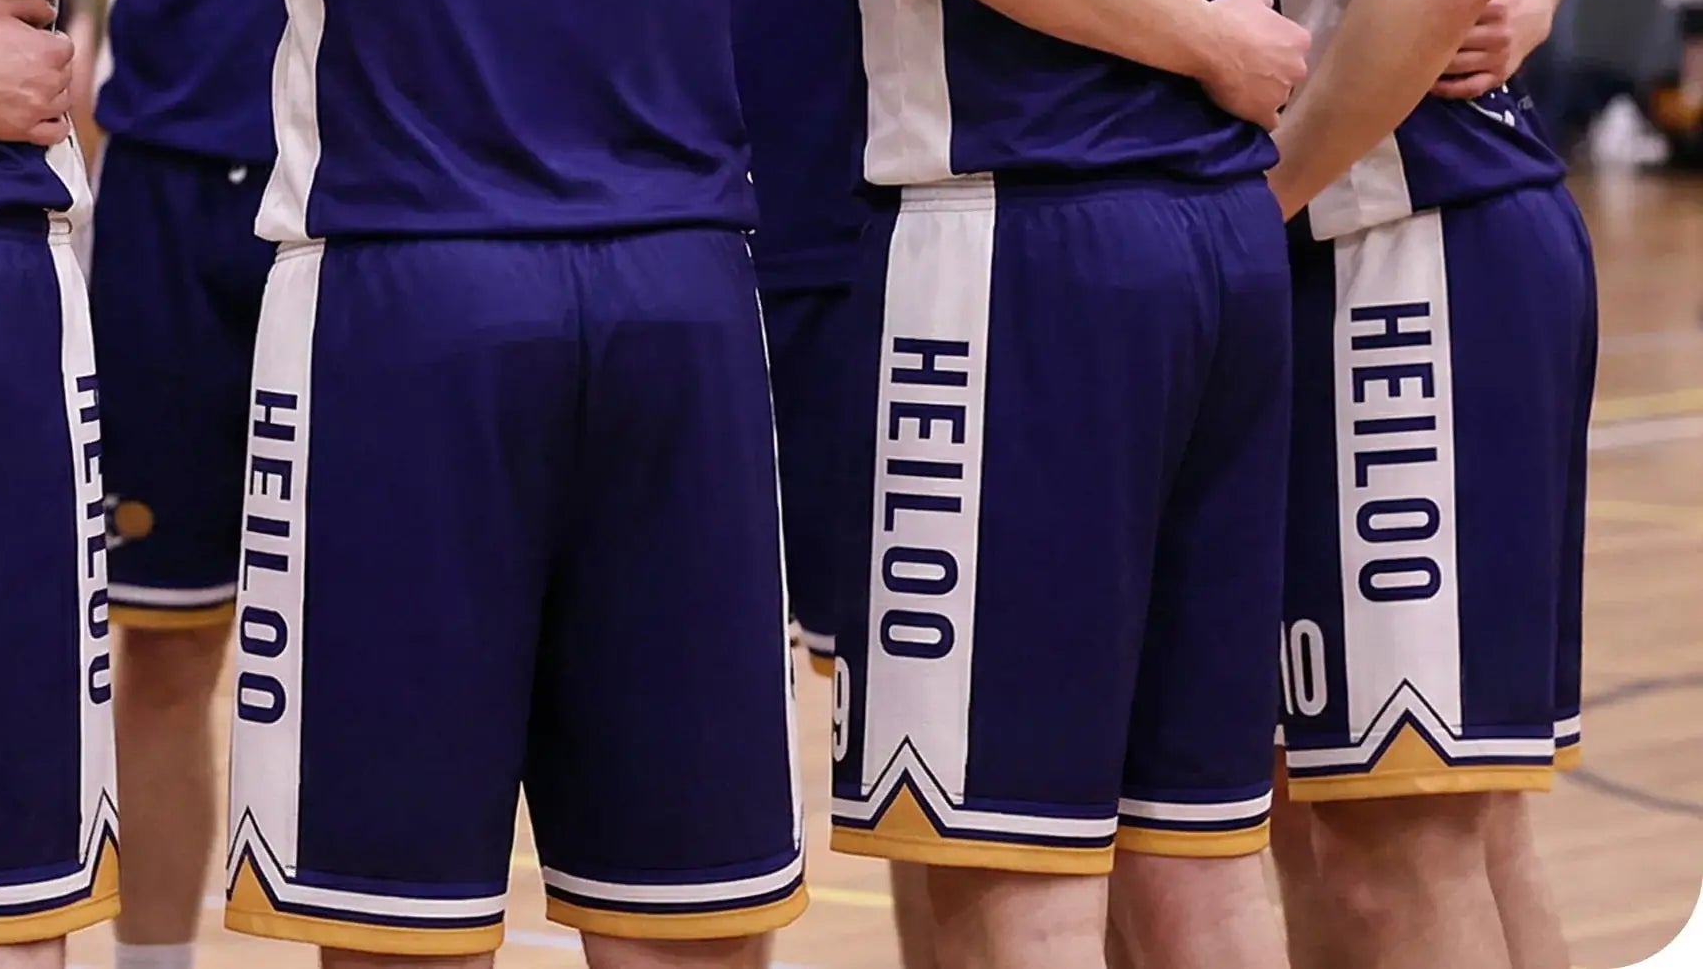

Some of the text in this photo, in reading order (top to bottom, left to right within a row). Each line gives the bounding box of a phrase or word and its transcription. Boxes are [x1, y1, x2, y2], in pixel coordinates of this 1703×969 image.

[238, 390, 297, 723] HEILOO
[880, 337, 969, 659] HEILOO
[1351, 302, 1441, 602] HEILOO
